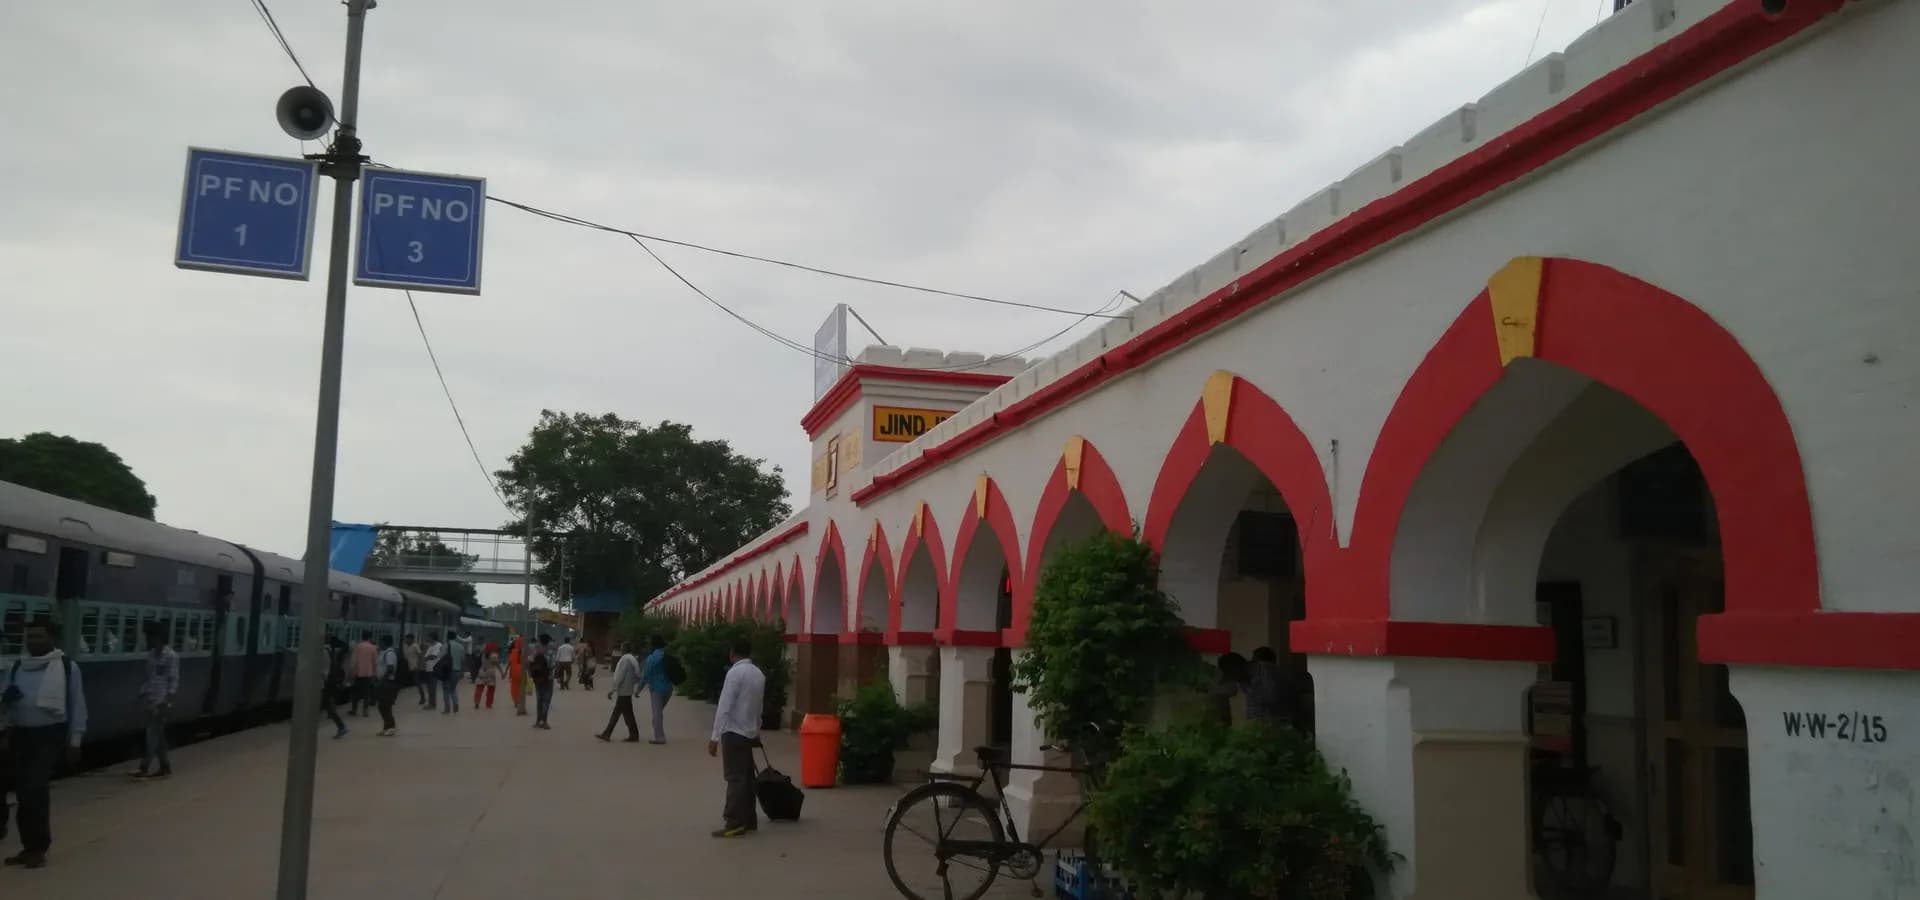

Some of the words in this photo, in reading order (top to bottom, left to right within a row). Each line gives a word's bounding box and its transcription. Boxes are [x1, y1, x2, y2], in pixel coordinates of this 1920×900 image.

[199, 174, 244, 199] PF
[248, 180, 300, 206] NO
[373, 193, 417, 217] PF
[421, 198, 469, 223] NO
[234, 224, 249, 247] 1
[407, 241, 425, 263] 3
